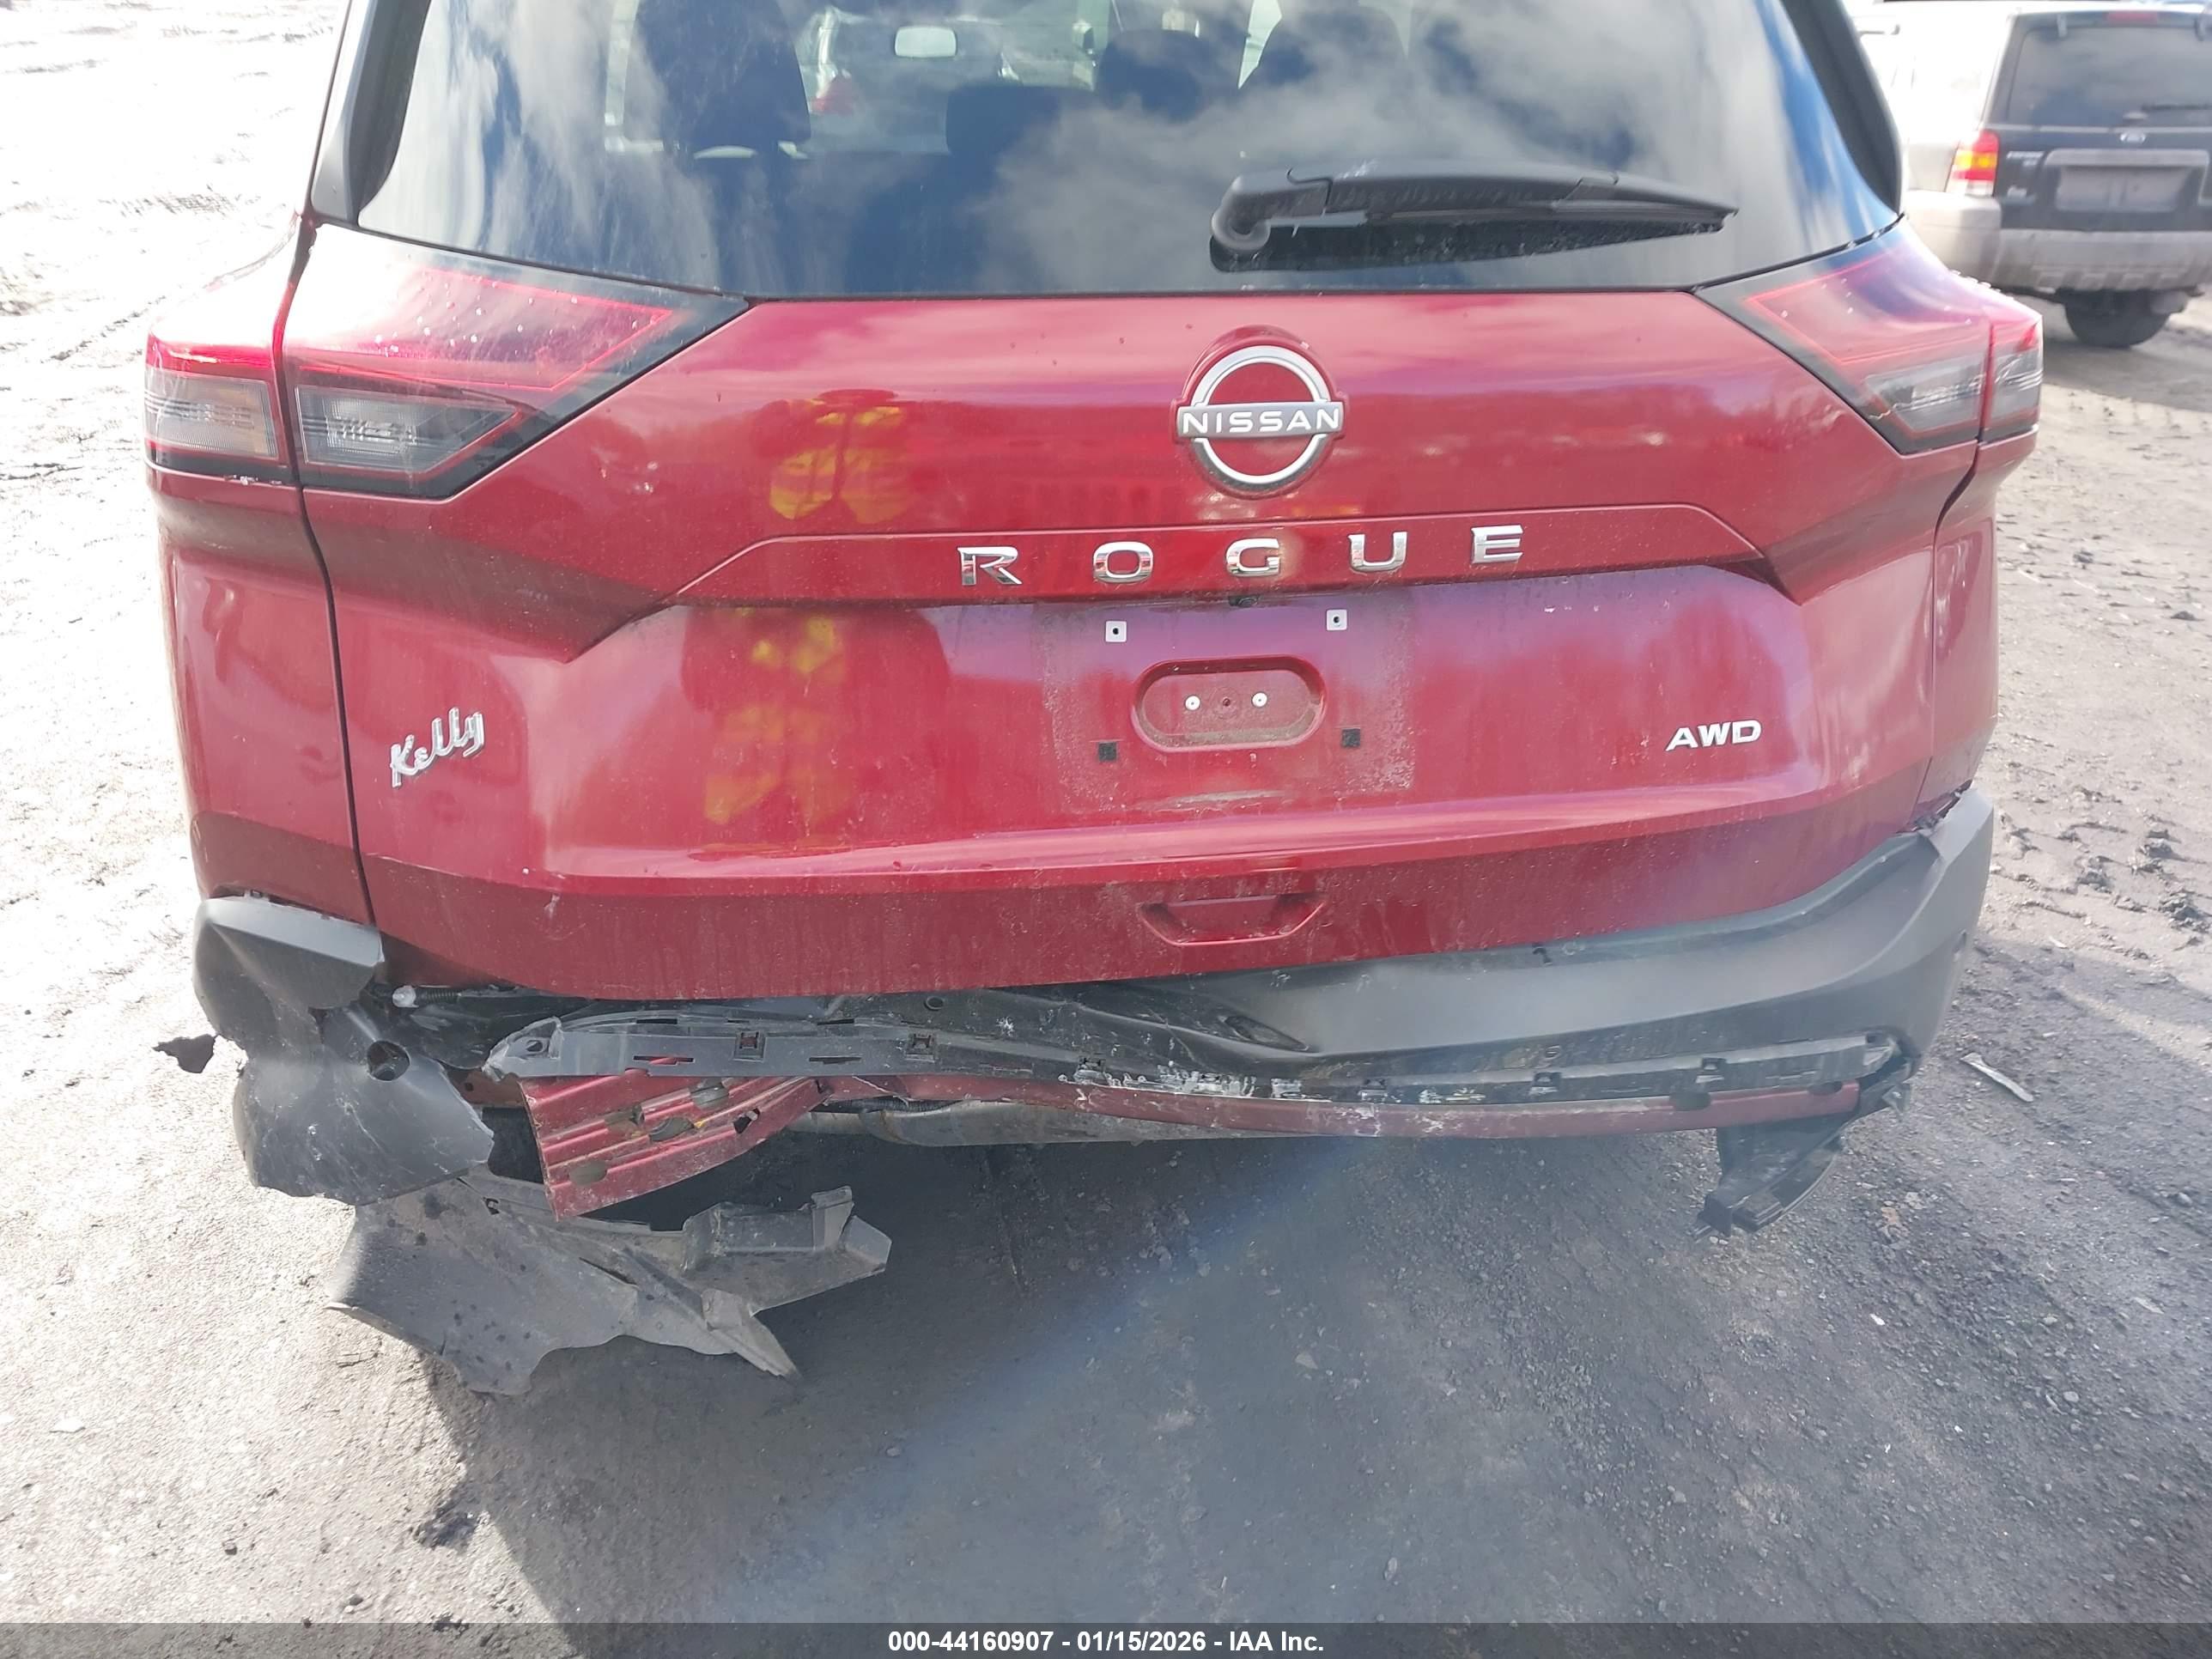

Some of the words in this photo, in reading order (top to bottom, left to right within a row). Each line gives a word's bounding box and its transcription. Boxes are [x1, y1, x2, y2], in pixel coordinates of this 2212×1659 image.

[1182, 408, 1340, 434] NISSAN
[957, 525, 1524, 586] ROGUE
[390, 707, 485, 788] Kelly
[1665, 720, 1762, 751] AWD
